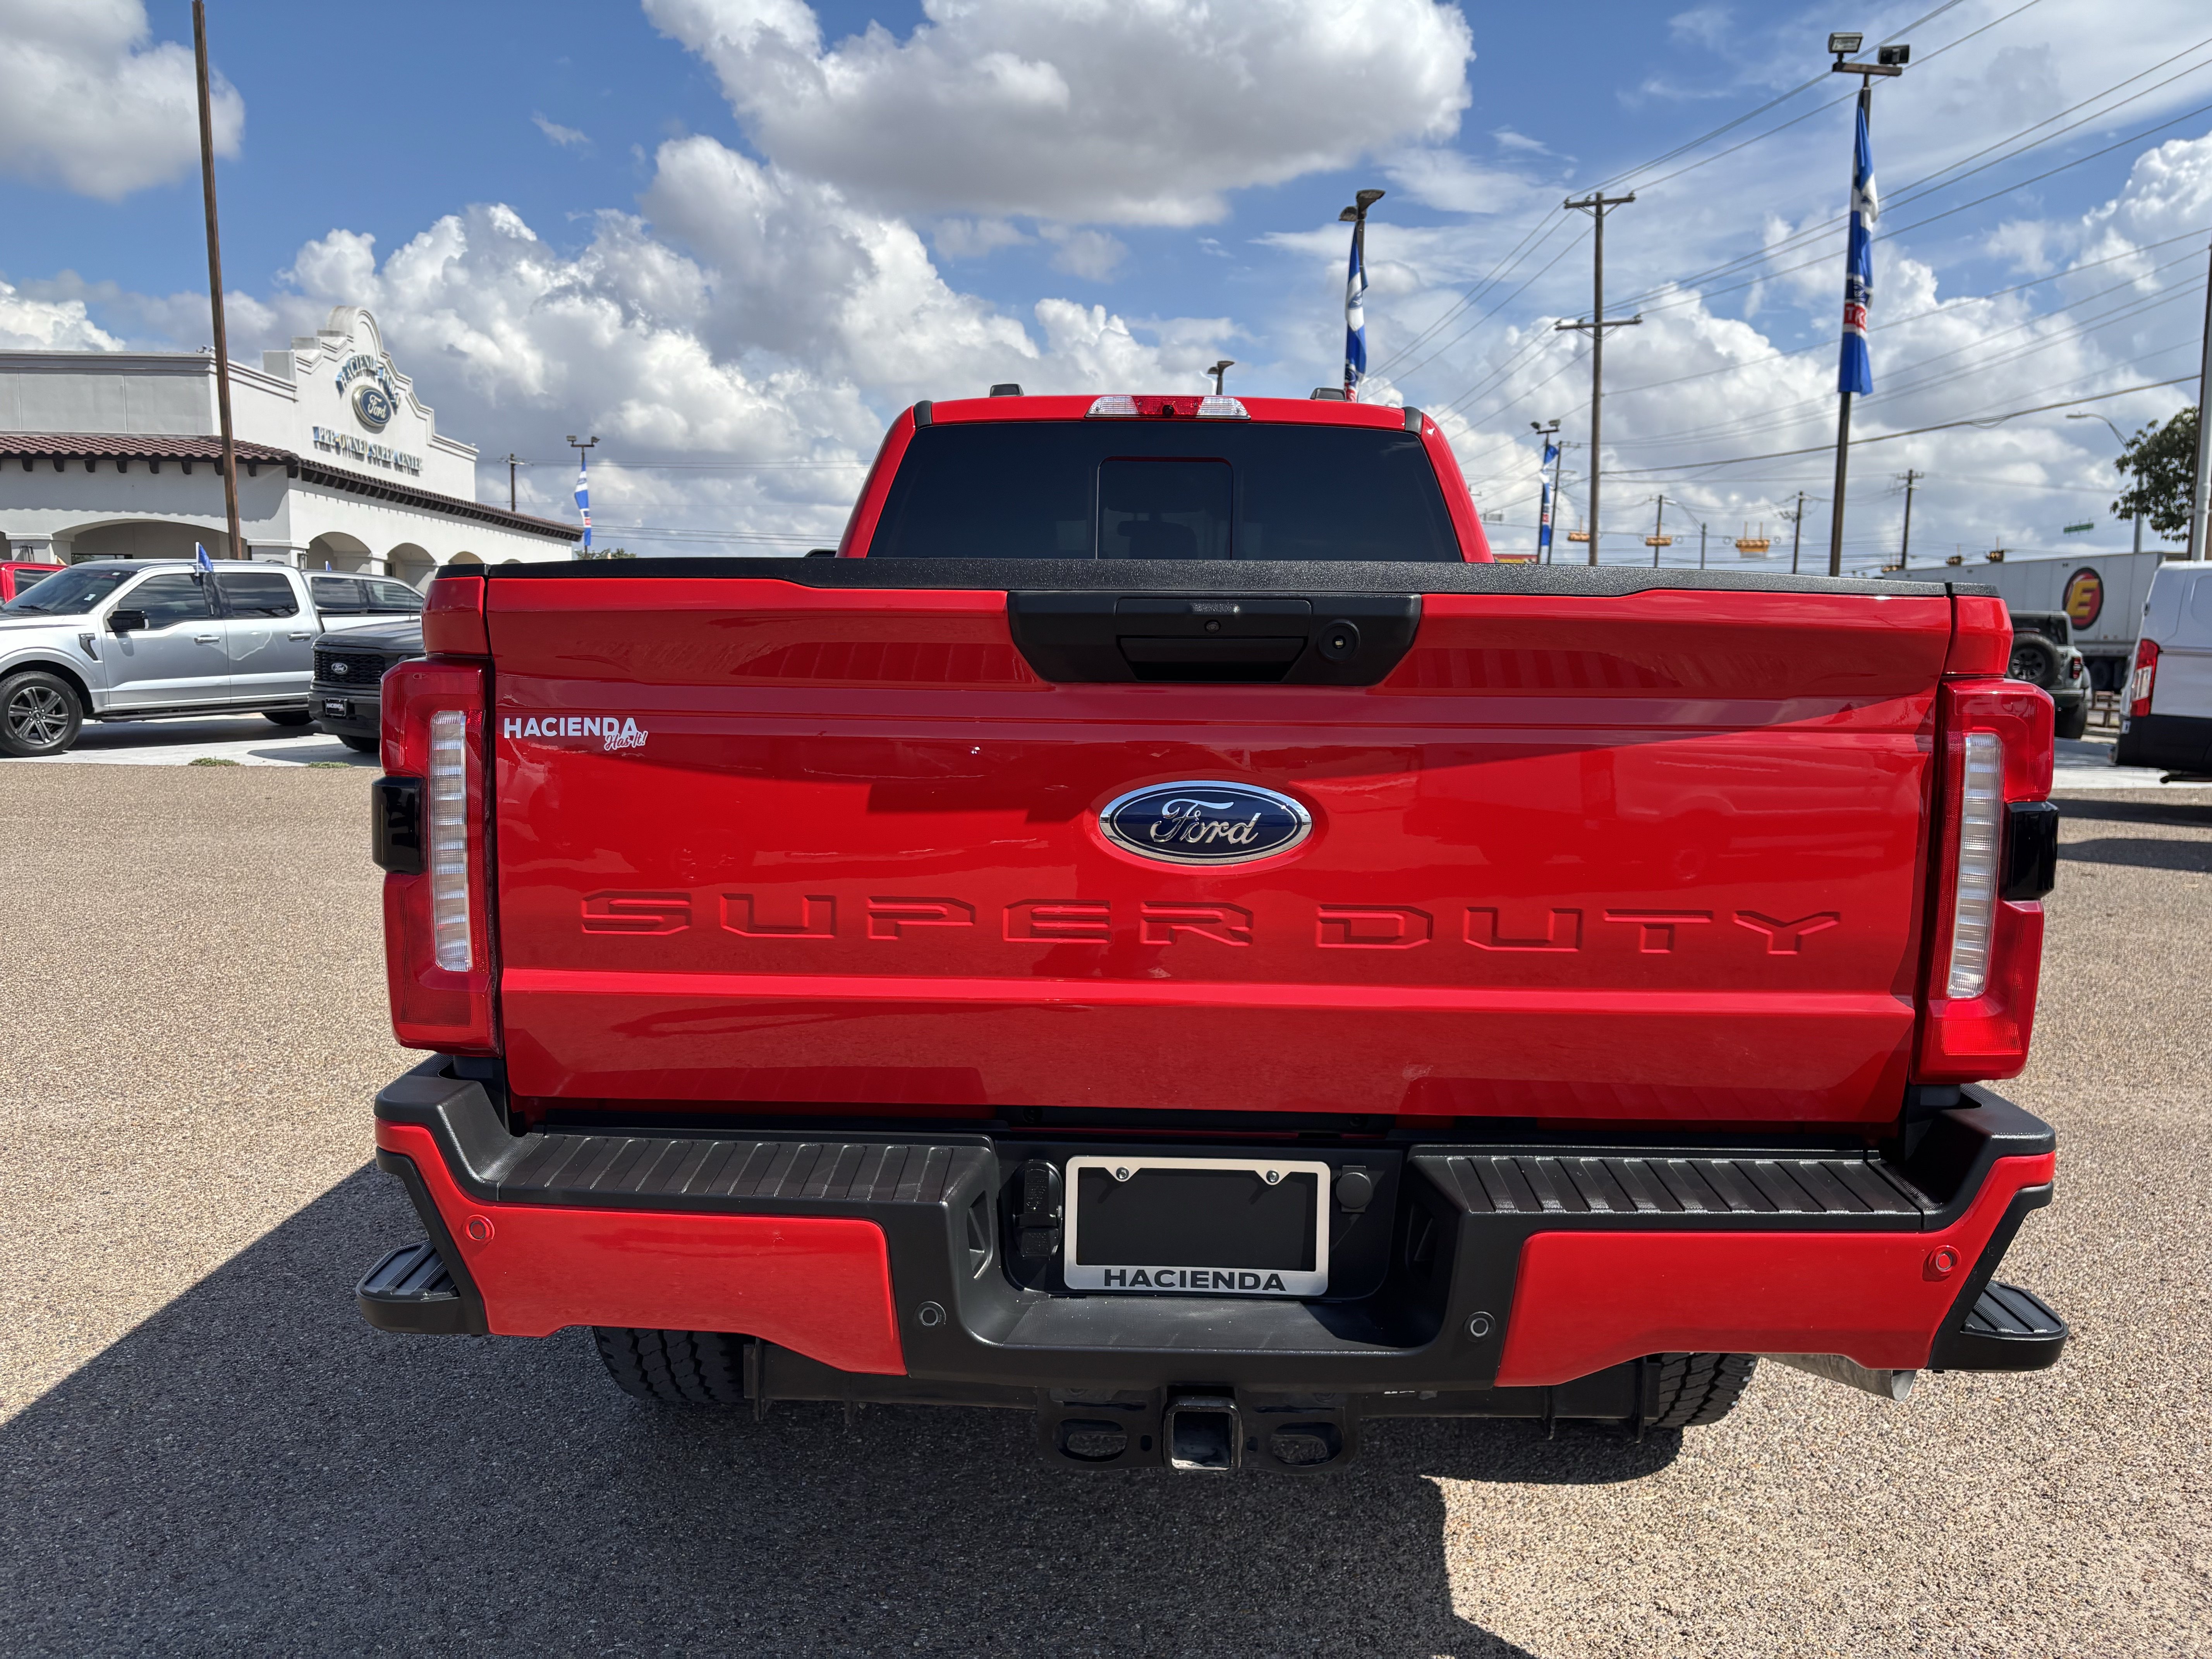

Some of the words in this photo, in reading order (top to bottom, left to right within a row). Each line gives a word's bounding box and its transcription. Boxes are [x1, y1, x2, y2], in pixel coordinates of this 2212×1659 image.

[368, 395, 387, 419] Ford
[313, 426, 368, 454] PRE-OWNED
[504, 717, 637, 739] HACIENDA
[604, 733, 630, 750] Has
[1150, 798, 1262, 845] Ford
[582, 891, 1254, 946] SUPER
[1318, 904, 1841, 954] DUTY
[1104, 1269, 1286, 1291] HACIENDA
